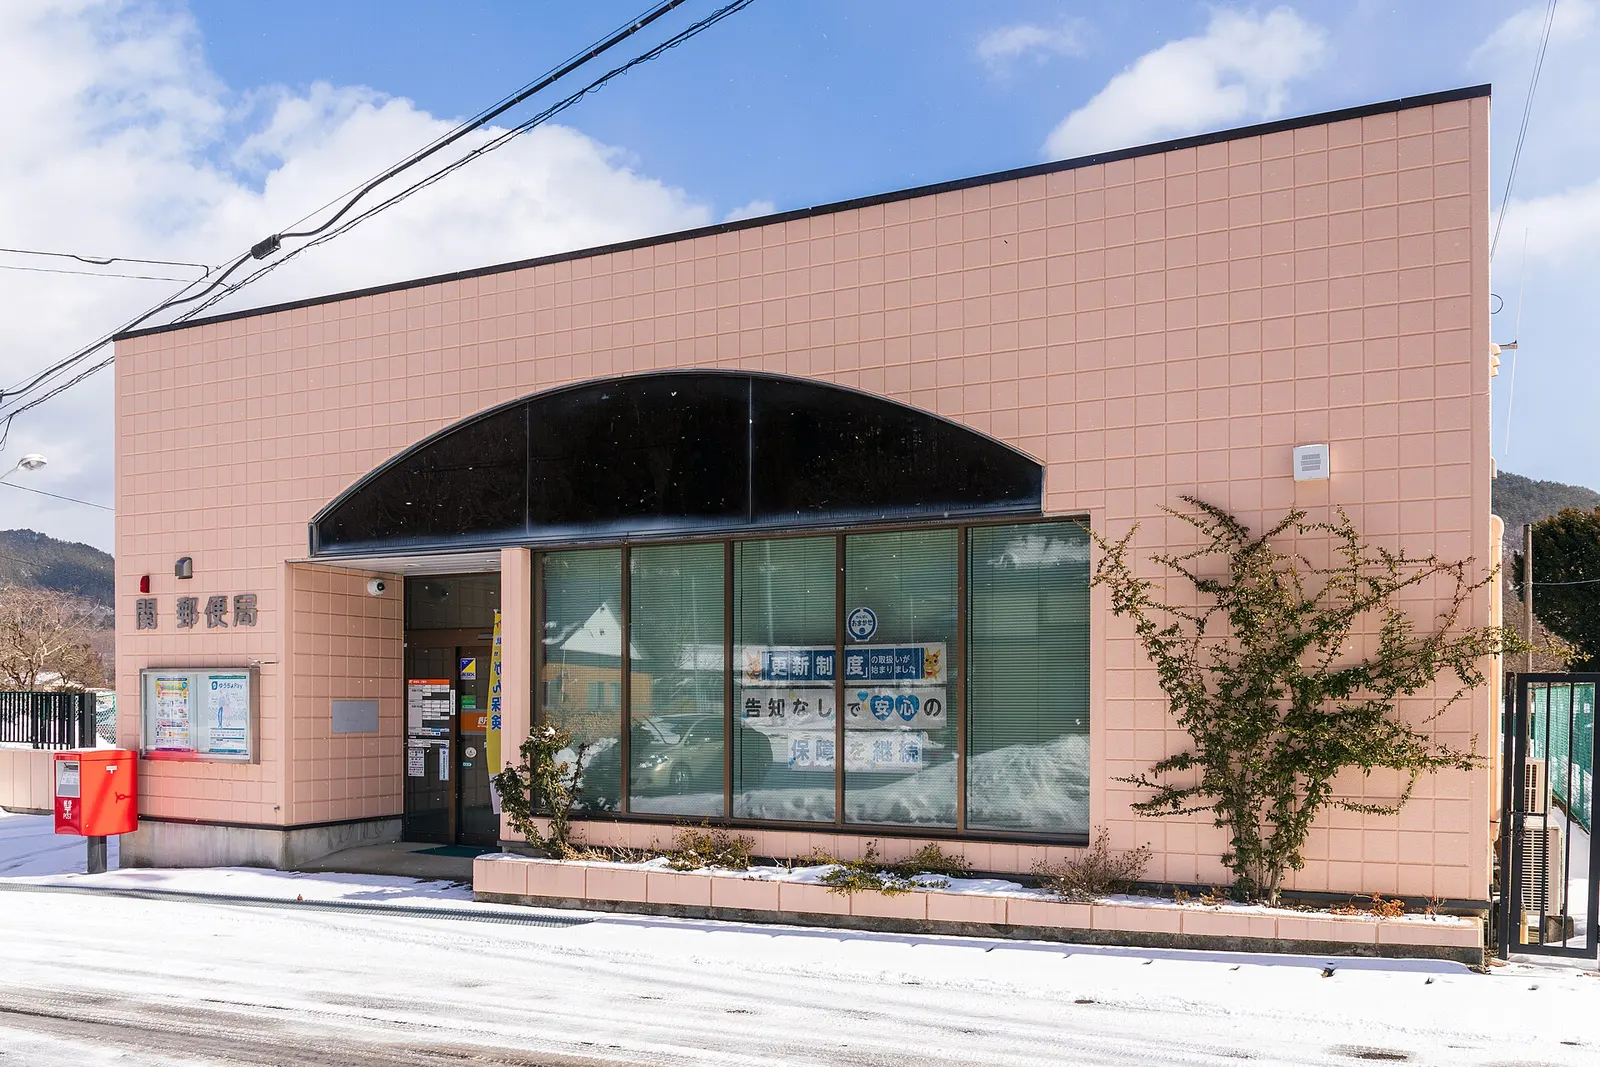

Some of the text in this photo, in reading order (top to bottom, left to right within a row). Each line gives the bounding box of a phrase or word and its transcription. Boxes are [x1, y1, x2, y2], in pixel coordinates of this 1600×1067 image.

[176, 594, 258, 629] 郵便局
[871, 655, 911, 664] の取扱いが
[871, 665, 916, 675] 始まりました
[745, 697, 942, 718] 告知なしで安心の
